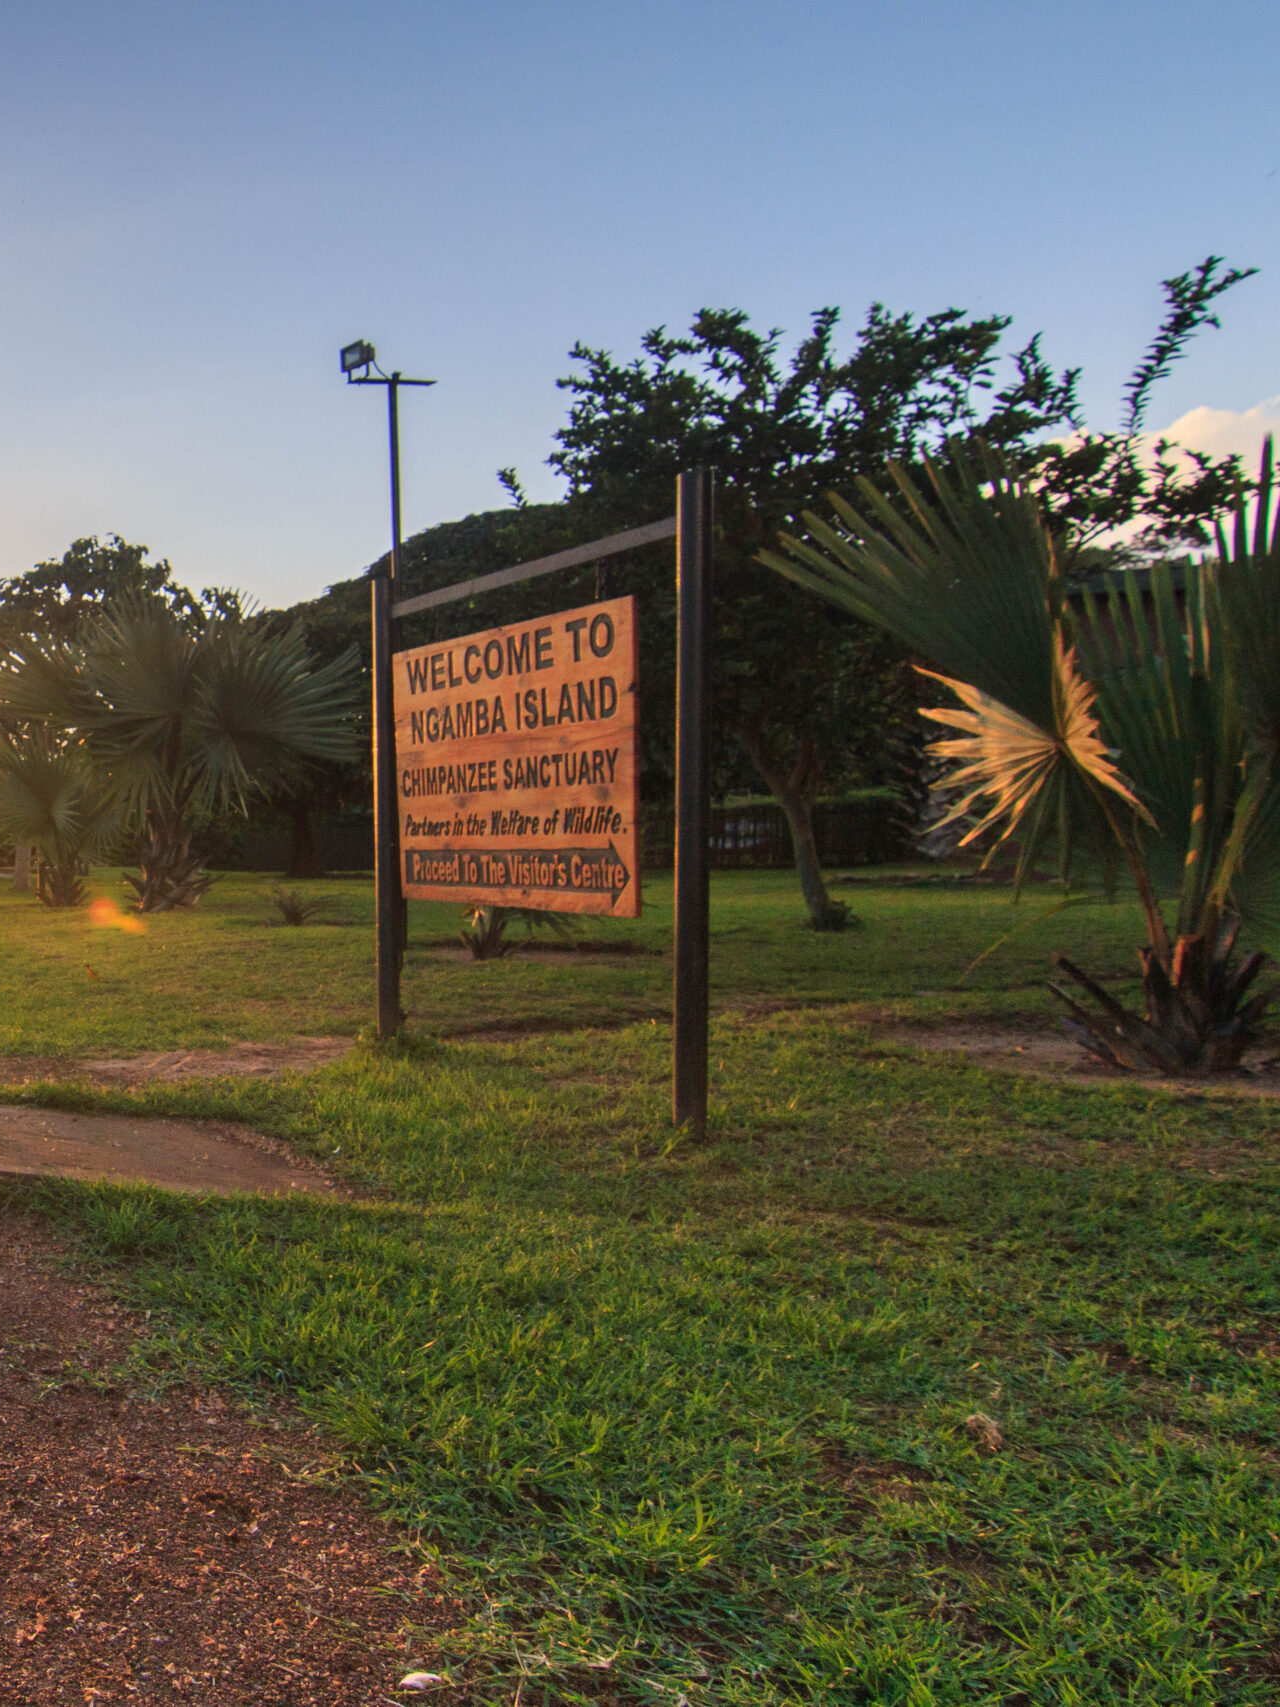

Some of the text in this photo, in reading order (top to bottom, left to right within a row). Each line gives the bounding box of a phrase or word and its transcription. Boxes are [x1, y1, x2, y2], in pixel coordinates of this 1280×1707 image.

[407, 612, 615, 695] WELCOME TO
[411, 676, 618, 744] NGAMBA ISLAND
[402, 748, 619, 797] CHIMPANZEE SANCTUARY
[405, 815, 450, 837] Partners
[453, 812, 464, 834] in
[466, 815, 485, 834] the
[491, 810, 539, 836] Welfare
[544, 809, 560, 832] of
[413, 855, 460, 882] Proceed
[462, 855, 477, 883] To
[480, 856, 505, 884] The
[570, 855, 626, 889] Centre
